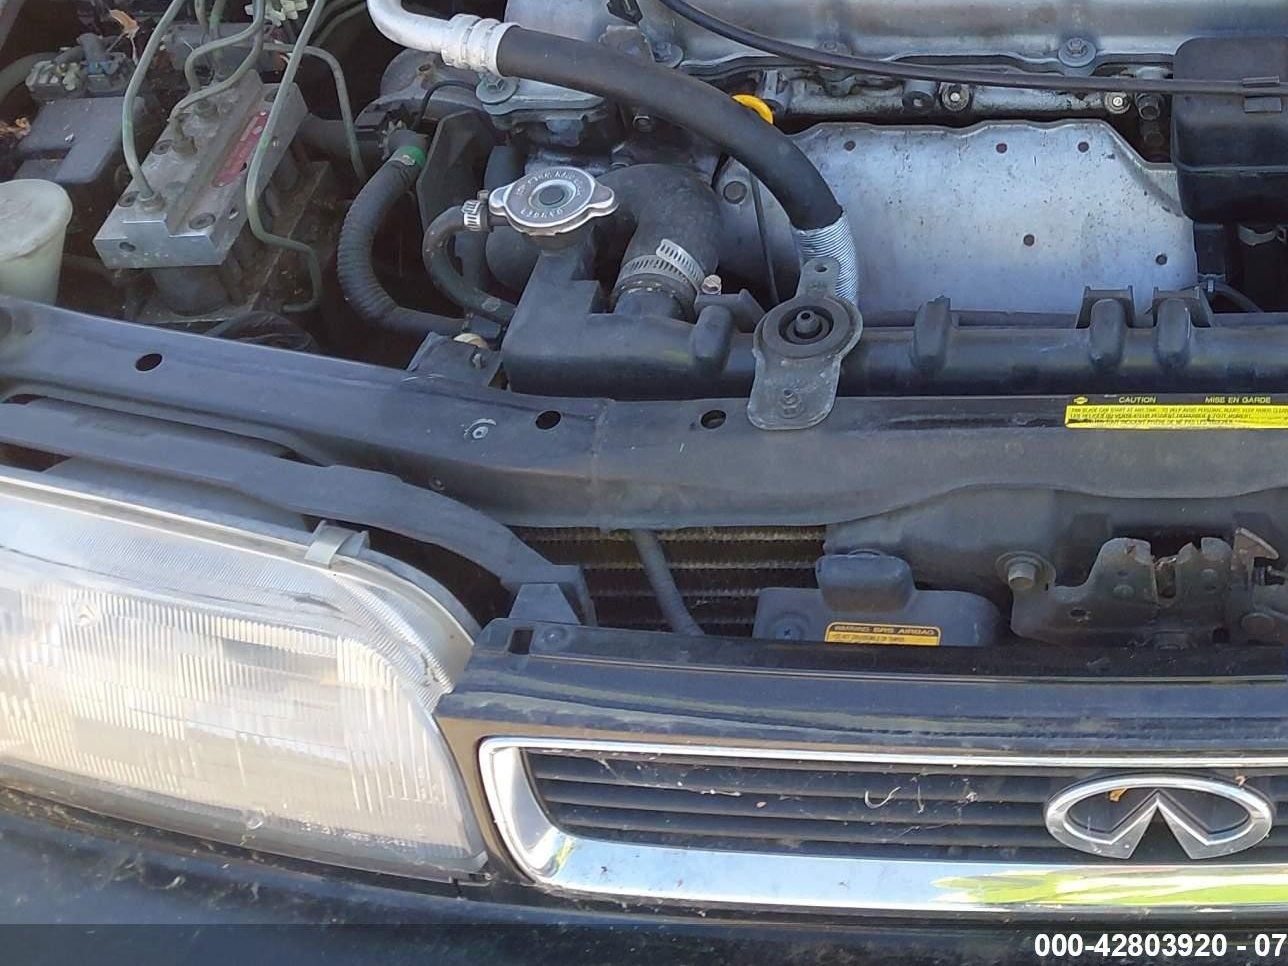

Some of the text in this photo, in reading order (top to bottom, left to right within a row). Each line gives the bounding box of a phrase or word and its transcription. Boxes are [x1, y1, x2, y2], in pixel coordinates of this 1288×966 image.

[1118, 396, 1271, 404] CAUTION MISE EN GARDE
